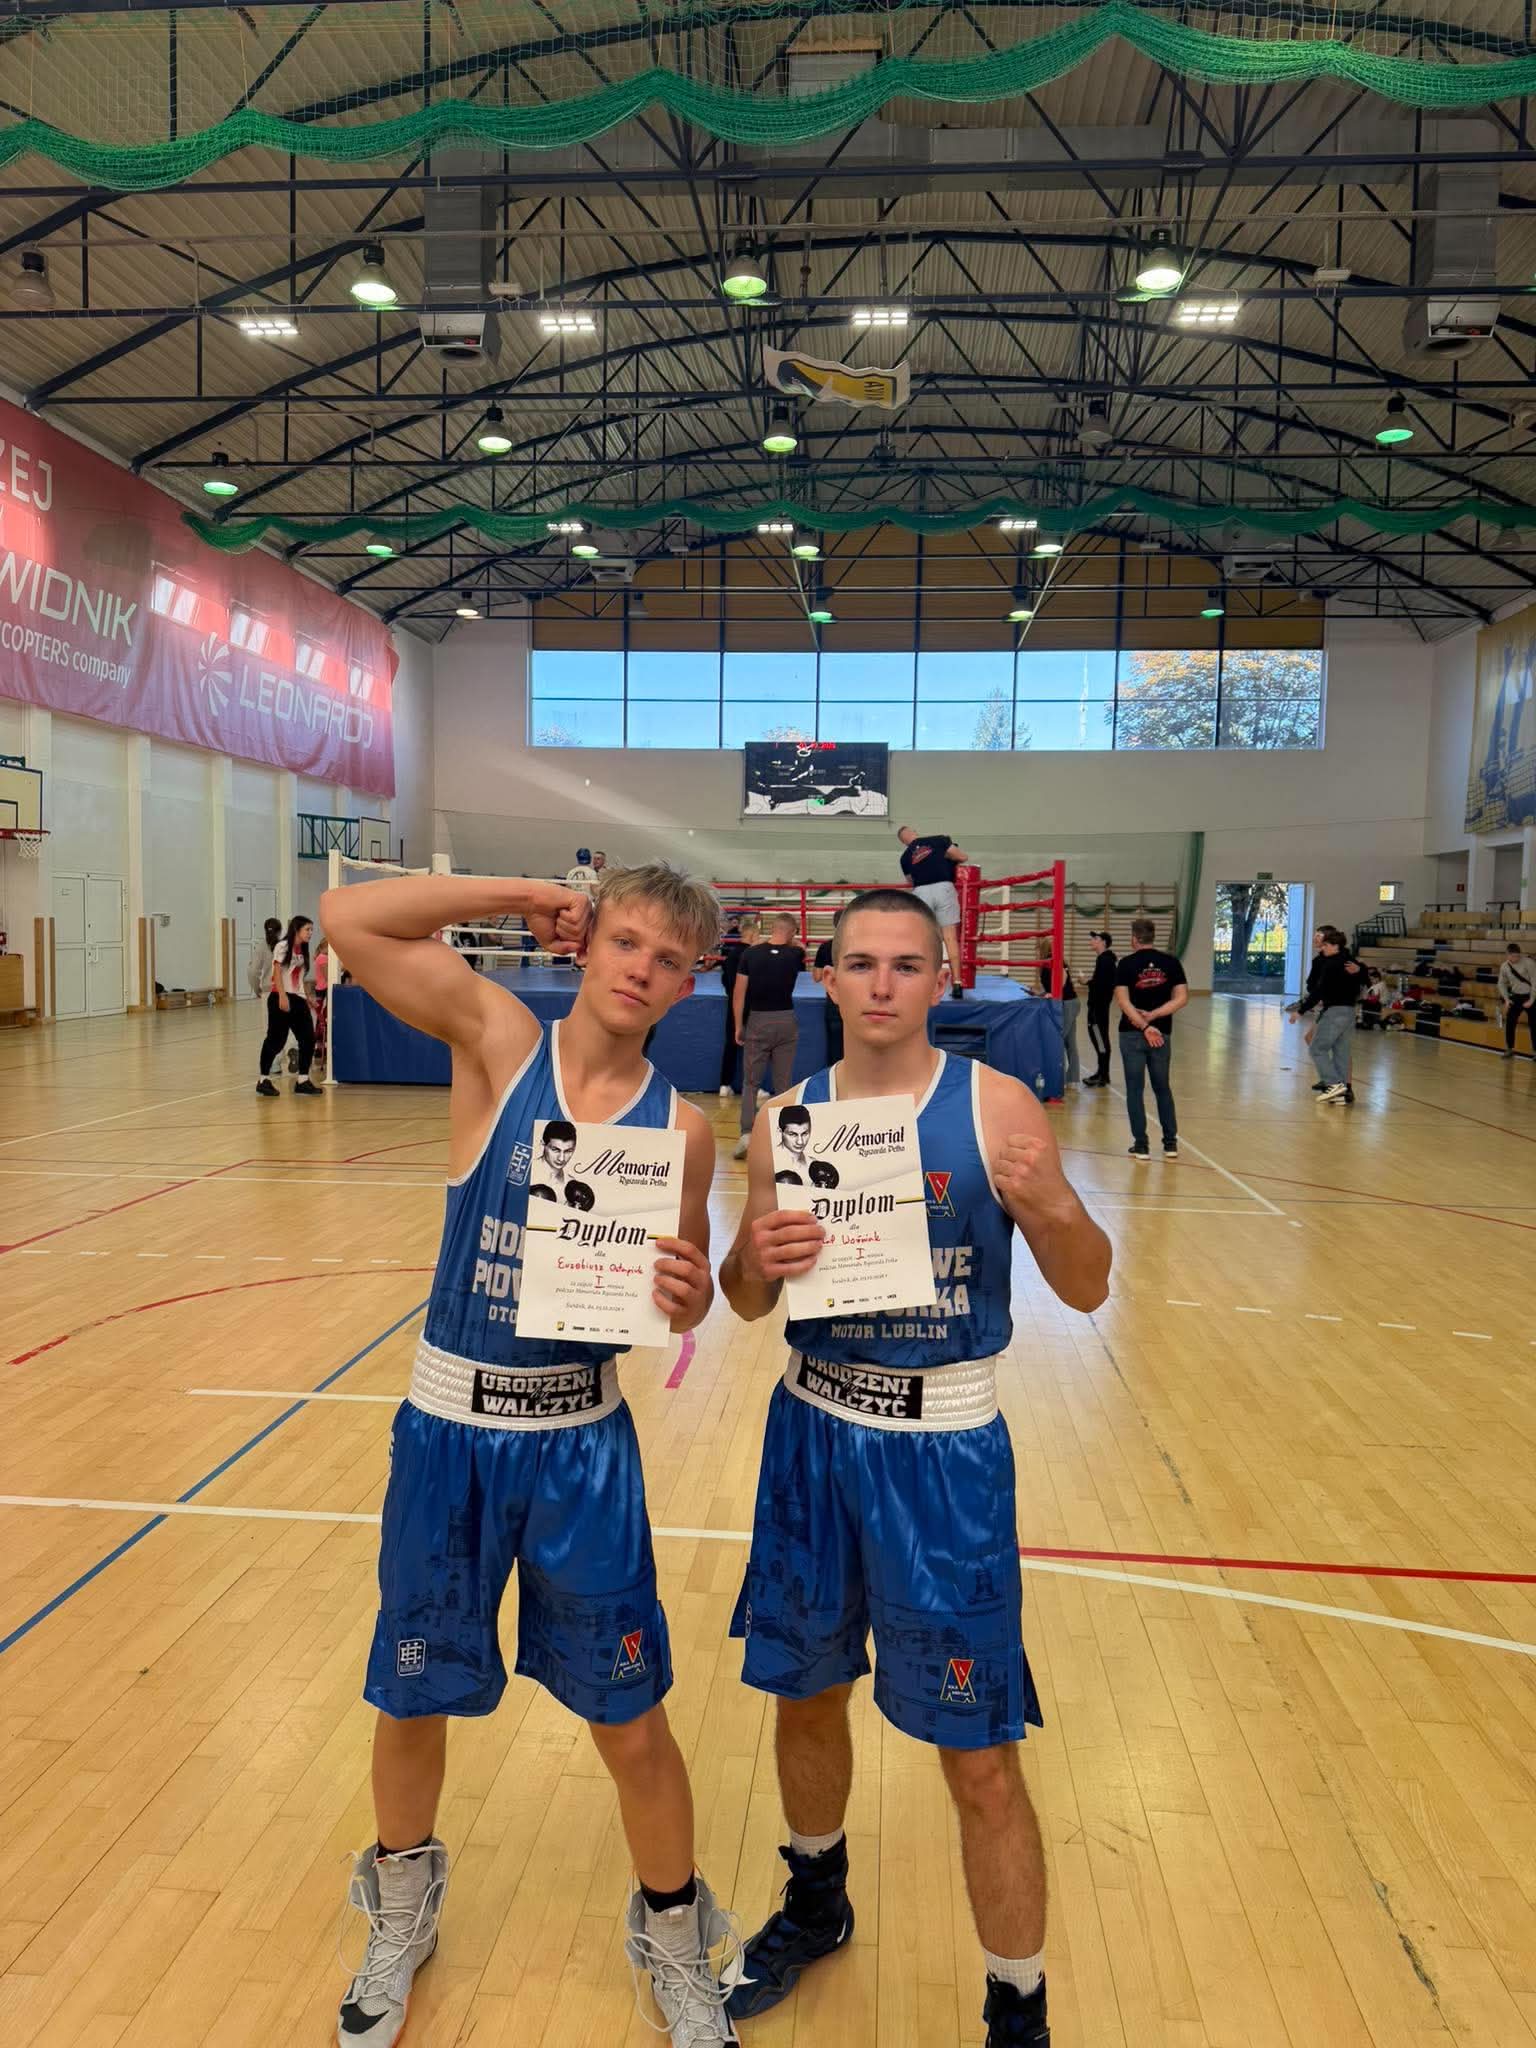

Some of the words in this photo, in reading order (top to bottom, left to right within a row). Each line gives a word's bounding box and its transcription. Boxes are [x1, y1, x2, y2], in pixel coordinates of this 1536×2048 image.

[0, 439, 53, 511] EJ
[0, 621, 70, 667] COPTERS
[72, 651, 131, 688] company
[811, 1192, 894, 1224] Dyplom
[557, 1217, 647, 1247] Dyplom
[832, 1323, 876, 1339] MOTOR
[881, 1323, 948, 1340] LUBLIN
[481, 1367, 595, 1393] URODZENI
[807, 1370, 906, 1417] WALCZYĆ
[482, 1388, 593, 1416] WALCZYĆ
